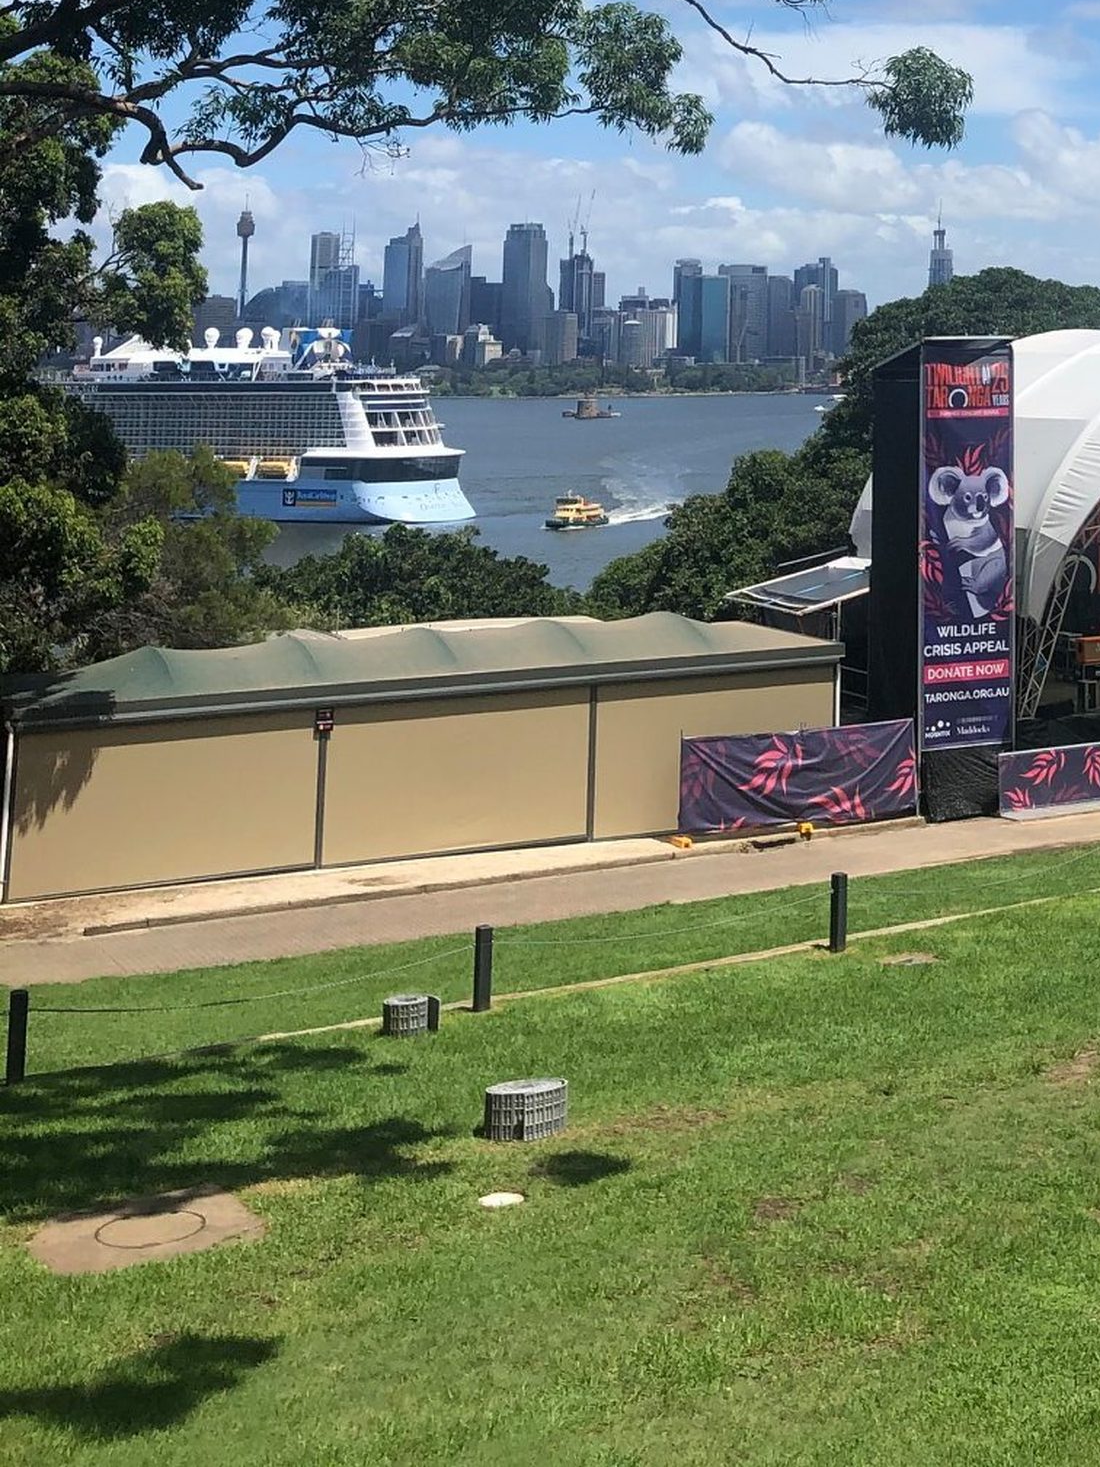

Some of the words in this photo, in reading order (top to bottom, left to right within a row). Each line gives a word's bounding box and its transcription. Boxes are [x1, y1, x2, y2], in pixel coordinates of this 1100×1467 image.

[990, 361, 1010, 393] 25
[937, 622, 997, 639] WILDLIFE
[923, 643, 962, 658] CRISIS
[963, 639, 1010, 655] APPEAL
[927, 665, 974, 681] DONATE
[975, 663, 1005, 677] NOW
[924, 687, 1010, 705] TARONGA.ORG.AU
